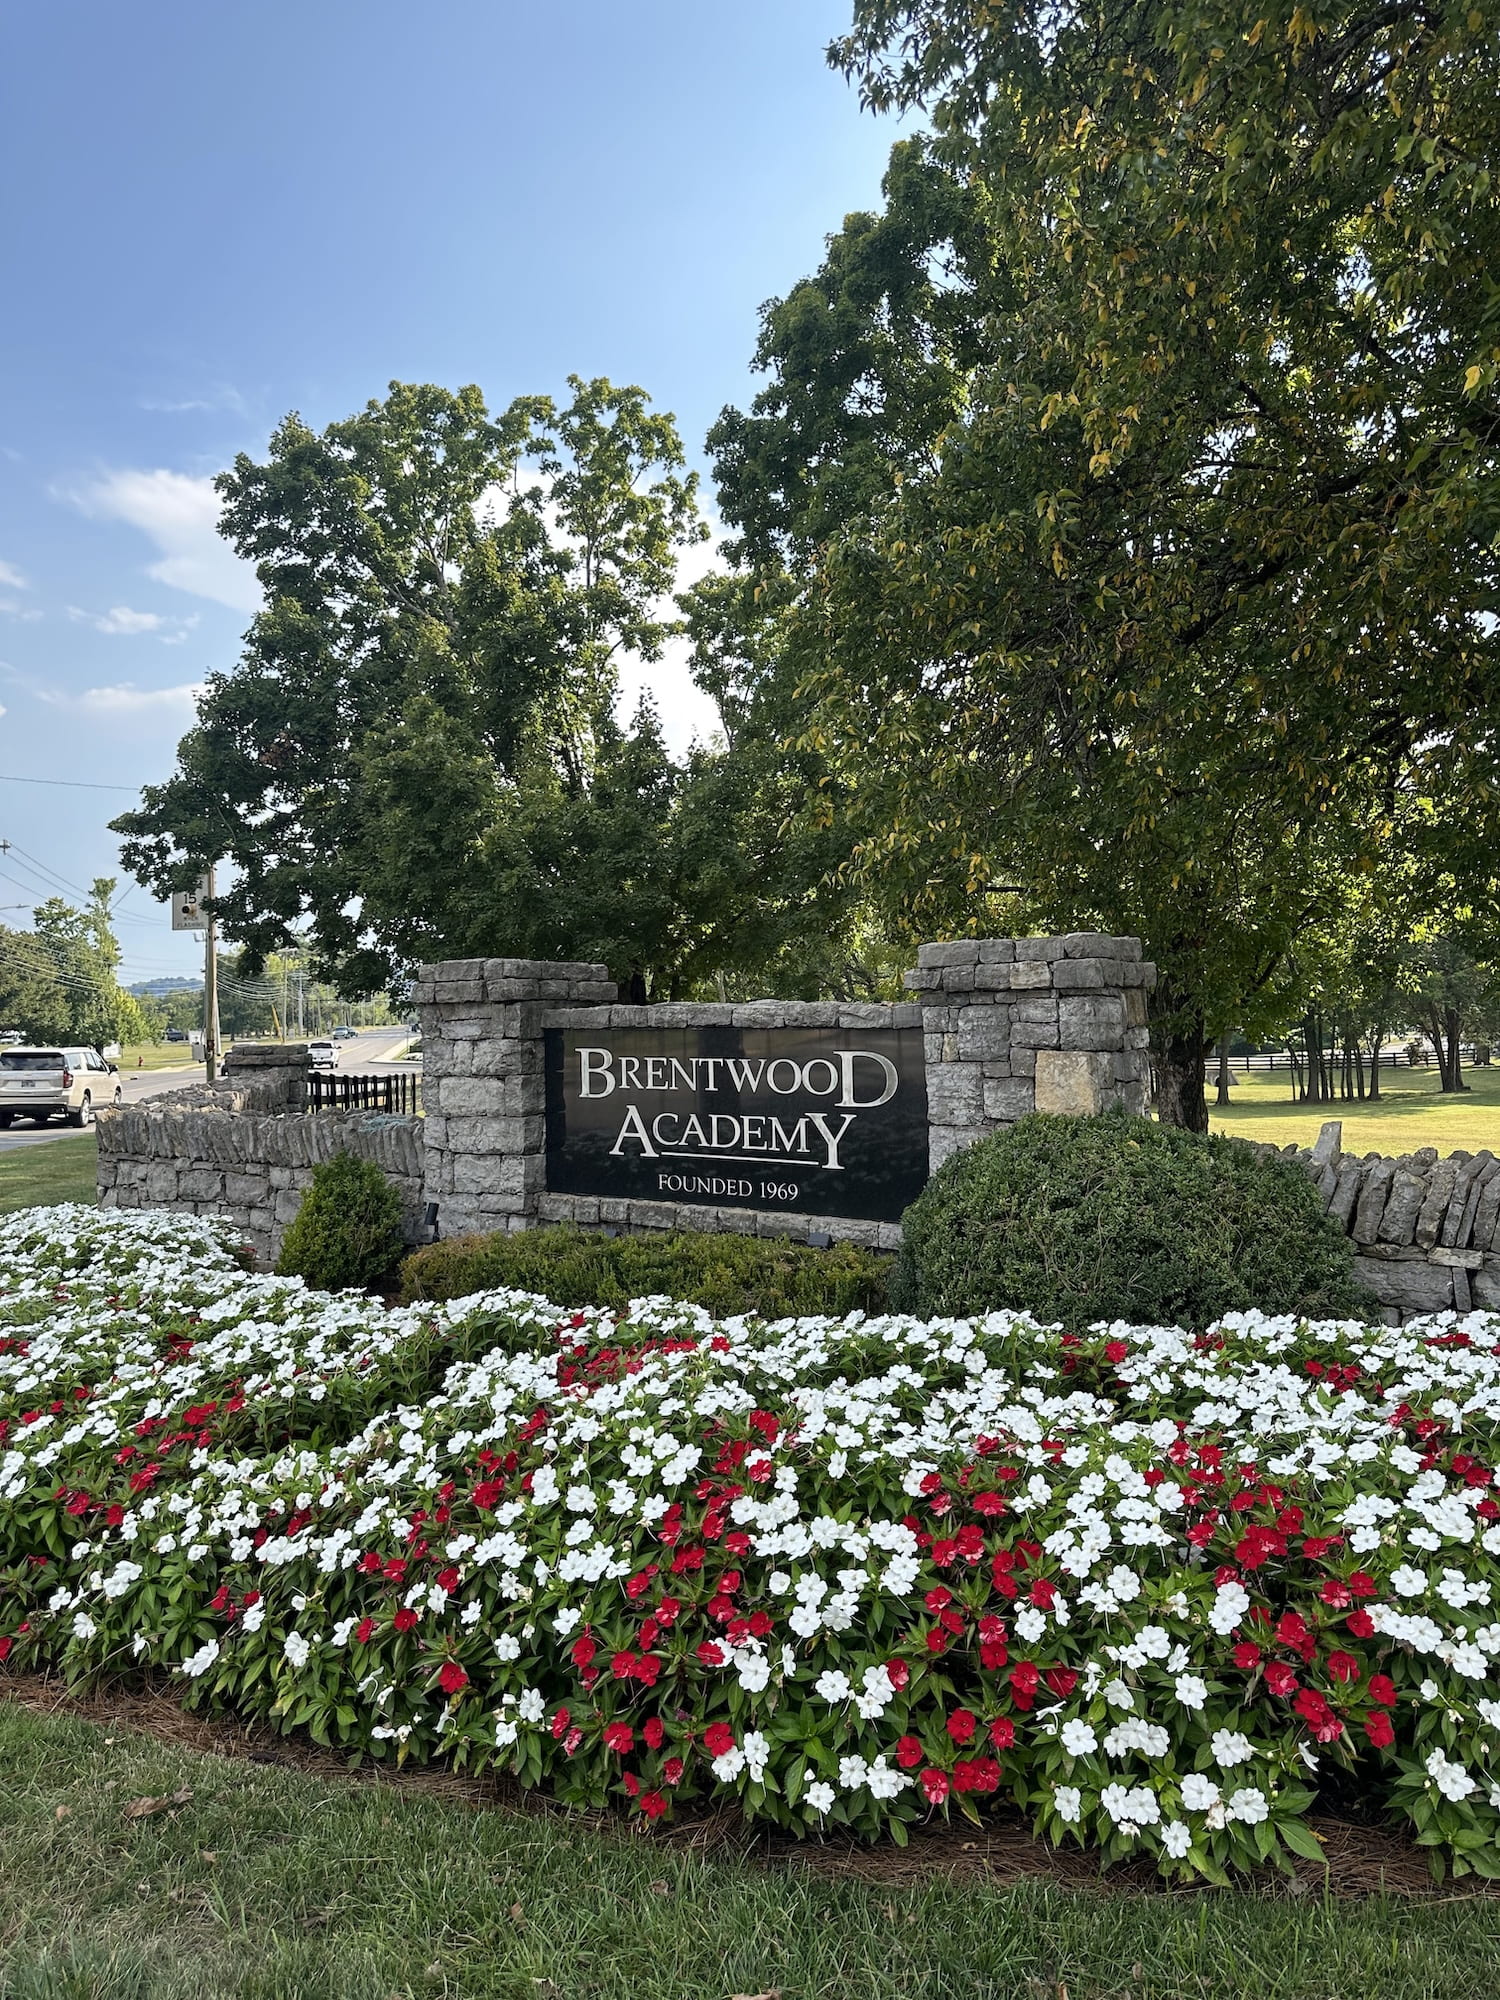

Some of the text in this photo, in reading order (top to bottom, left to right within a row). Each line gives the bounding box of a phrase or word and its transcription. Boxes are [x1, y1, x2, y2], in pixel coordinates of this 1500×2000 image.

[184, 893, 197, 904] 15
[575, 1047, 899, 1108] BRENTWOOD
[609, 1105, 857, 1170] ACADEMY
[658, 1174, 799, 1201] FOUNDED 1969
